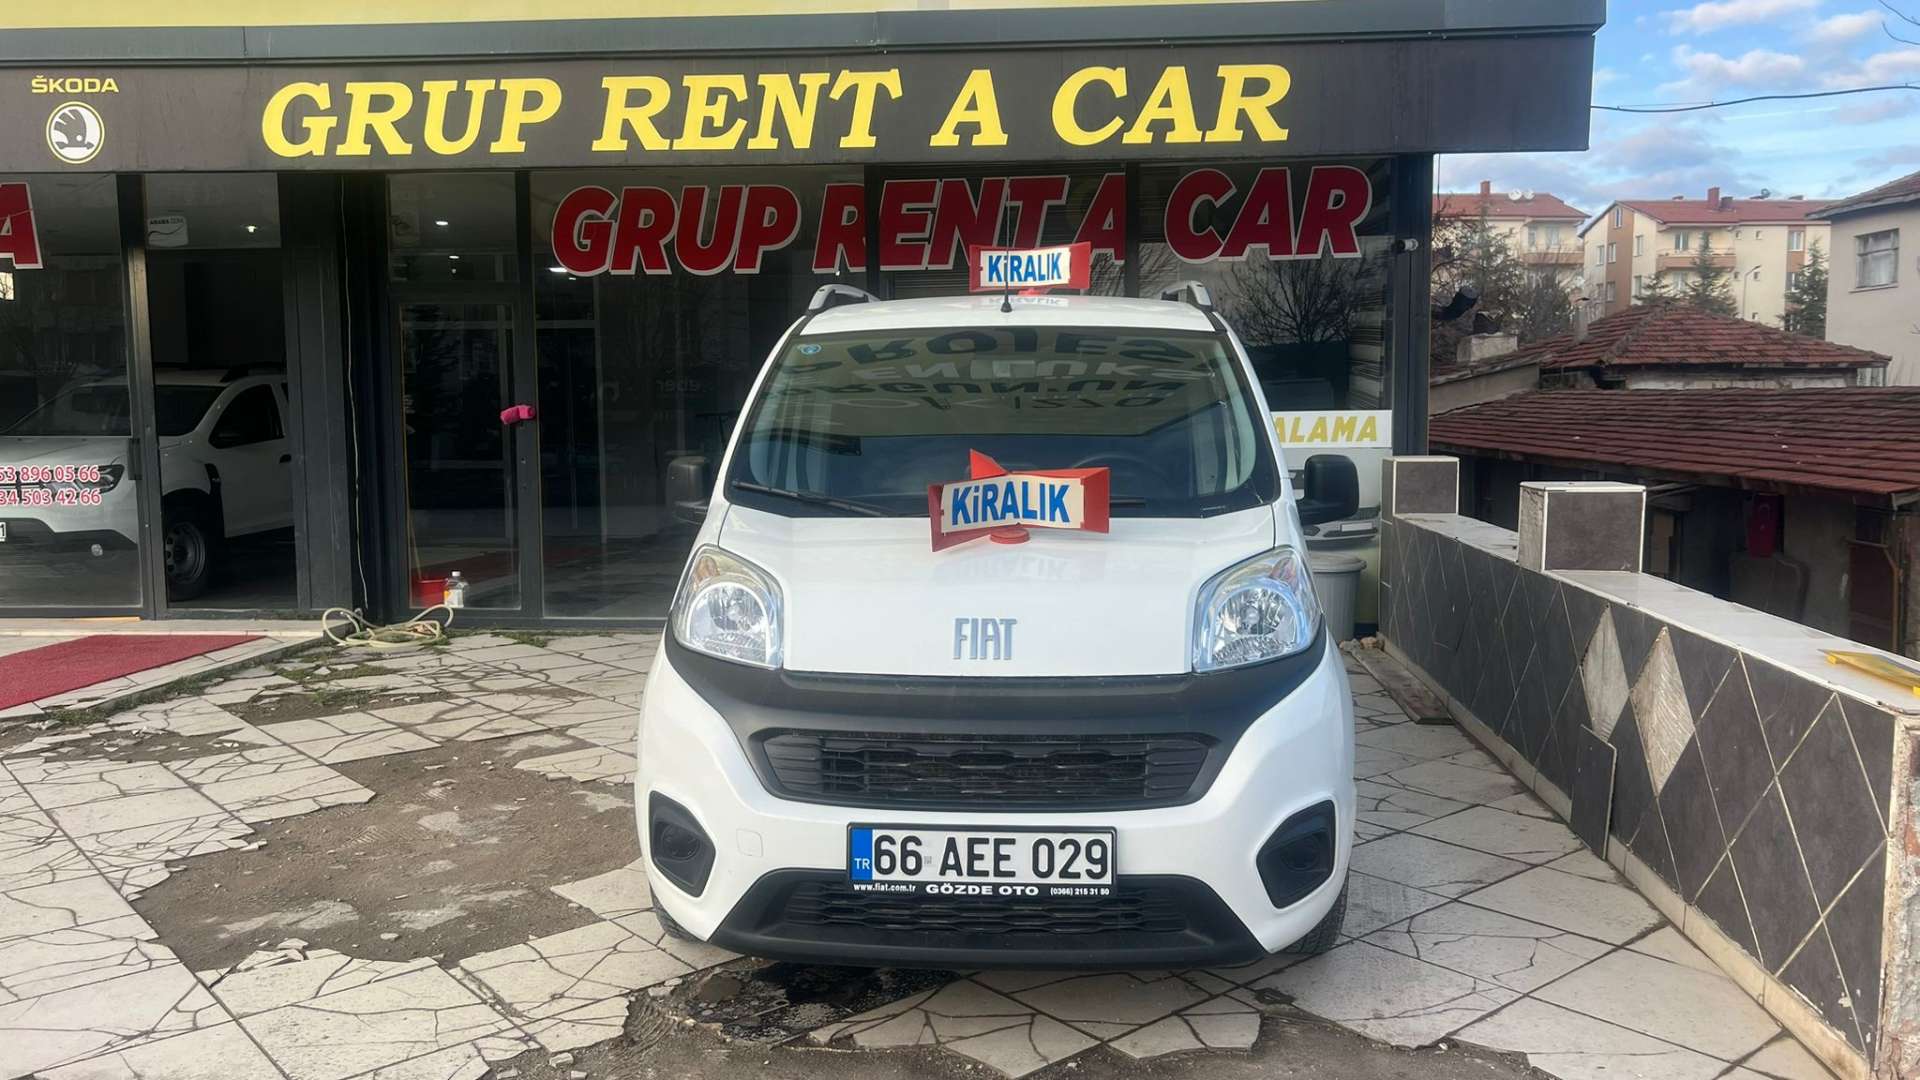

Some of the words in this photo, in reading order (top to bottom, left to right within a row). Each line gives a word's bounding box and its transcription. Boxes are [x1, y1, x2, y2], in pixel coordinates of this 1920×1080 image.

[31, 75, 119, 93] ŠKODA
[262, 77, 562, 158] GRUP
[591, 69, 903, 152] RENT
[930, 69, 1008, 147] A
[1052, 64, 1291, 145] CAR
[551, 184, 801, 276] GRUP
[812, 175, 1071, 275] RENT
[1073, 172, 1126, 265] A
[1164, 165, 1373, 263] CAR
[20, 466, 51, 482] 896
[54, 465, 76, 482] 05
[79, 465, 100, 481] 66
[22, 489, 52, 505] 503
[56, 489, 77, 505] 42
[80, 489, 101, 505] 66
[953, 617, 1018, 661] FIAT
[854, 857, 871, 870] TR
[873, 834, 923, 877] 66
[938, 836, 1017, 878] AEE
[1031, 837, 1109, 880] 029
[853, 882, 917, 893] www.fiat.com.tr
[925, 883, 994, 896] GÖZDE
[998, 885, 1040, 897] OTO
